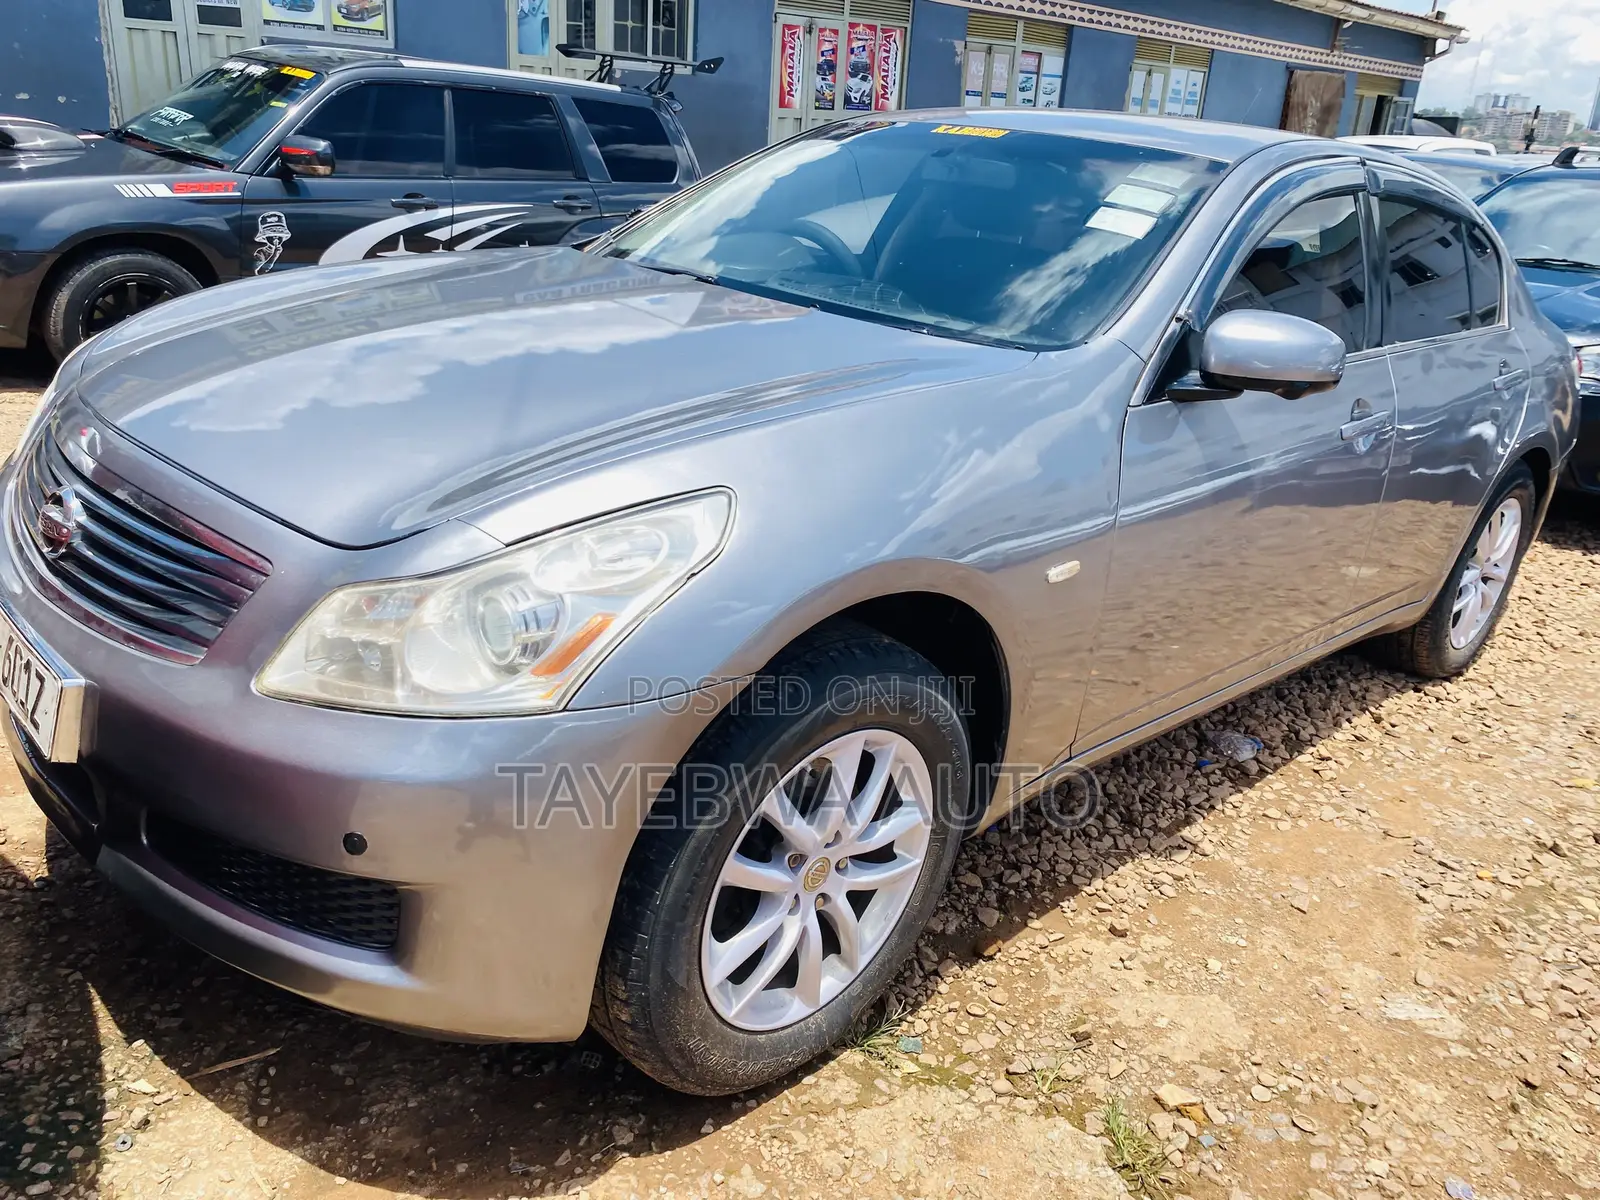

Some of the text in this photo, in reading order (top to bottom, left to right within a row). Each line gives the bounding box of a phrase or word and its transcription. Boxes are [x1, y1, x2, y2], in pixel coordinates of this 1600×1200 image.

[786, 28, 799, 99] MALALA
[880, 32, 895, 102] MALALA
[172, 181, 238, 194] SPORT
